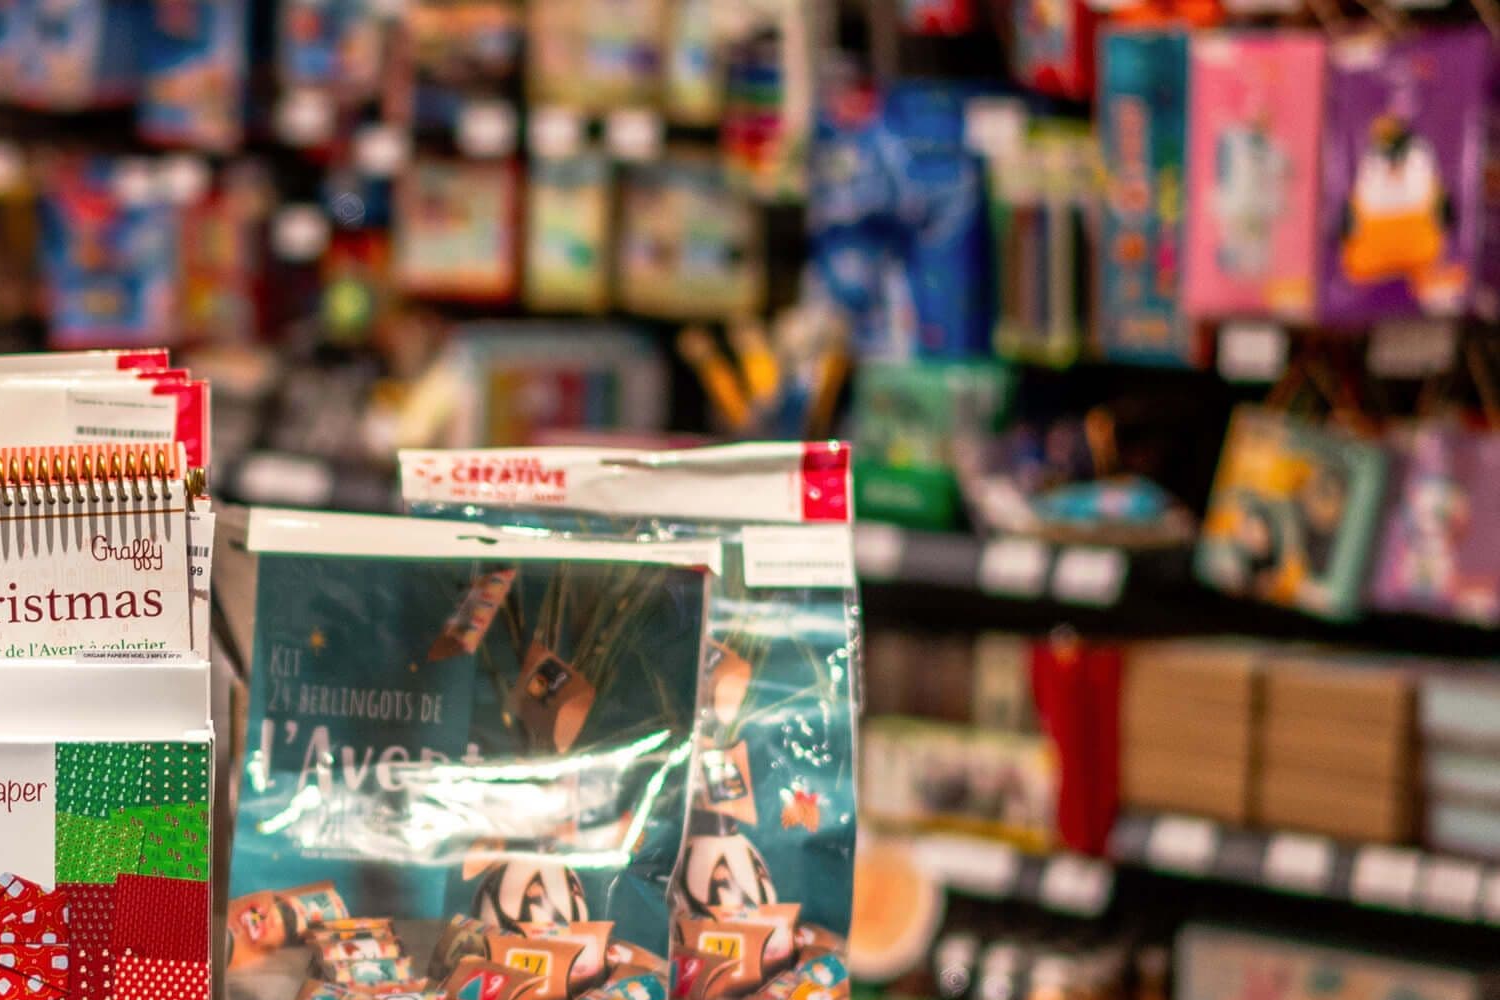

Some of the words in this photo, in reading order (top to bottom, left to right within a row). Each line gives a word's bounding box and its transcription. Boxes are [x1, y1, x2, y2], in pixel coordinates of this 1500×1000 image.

[91, 535, 163, 571] Graffy
[5, 644, 25, 659] de
[29, 642, 84, 658] l'Aven
[269, 644, 301, 678] KIT
[299, 683, 413, 721] BERLINGOTS
[420, 694, 443, 724] DE
